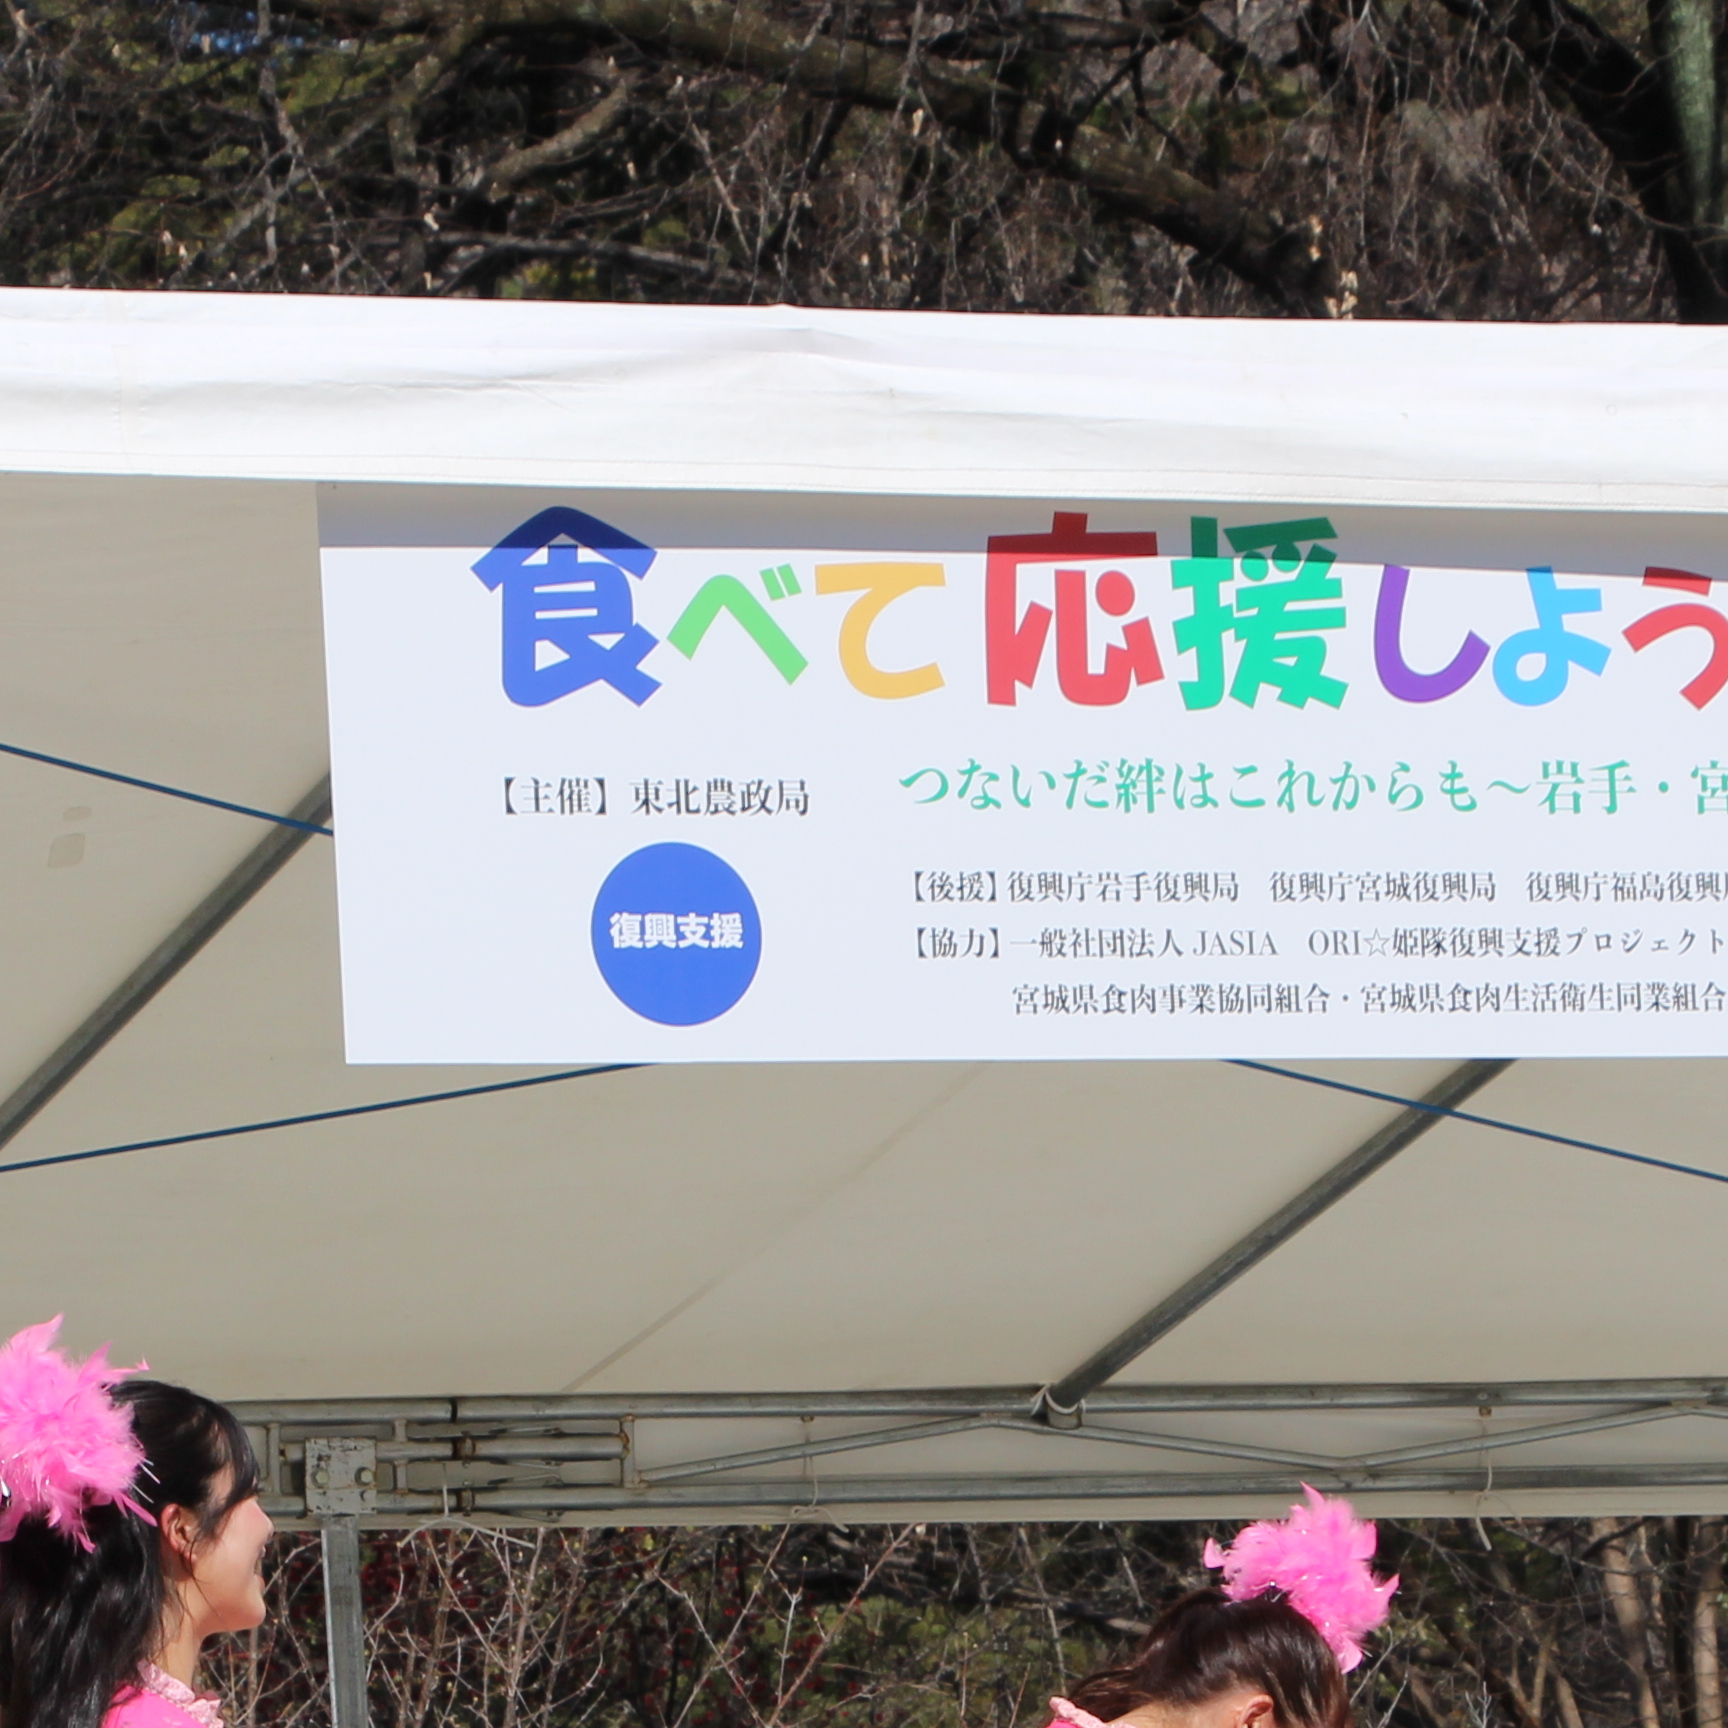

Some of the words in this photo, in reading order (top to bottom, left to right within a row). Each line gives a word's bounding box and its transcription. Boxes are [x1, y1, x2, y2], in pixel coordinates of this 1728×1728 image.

[1268, 870, 1497, 903] 復興庁宮城復興局
[610, 912, 745, 950] 復興支援
